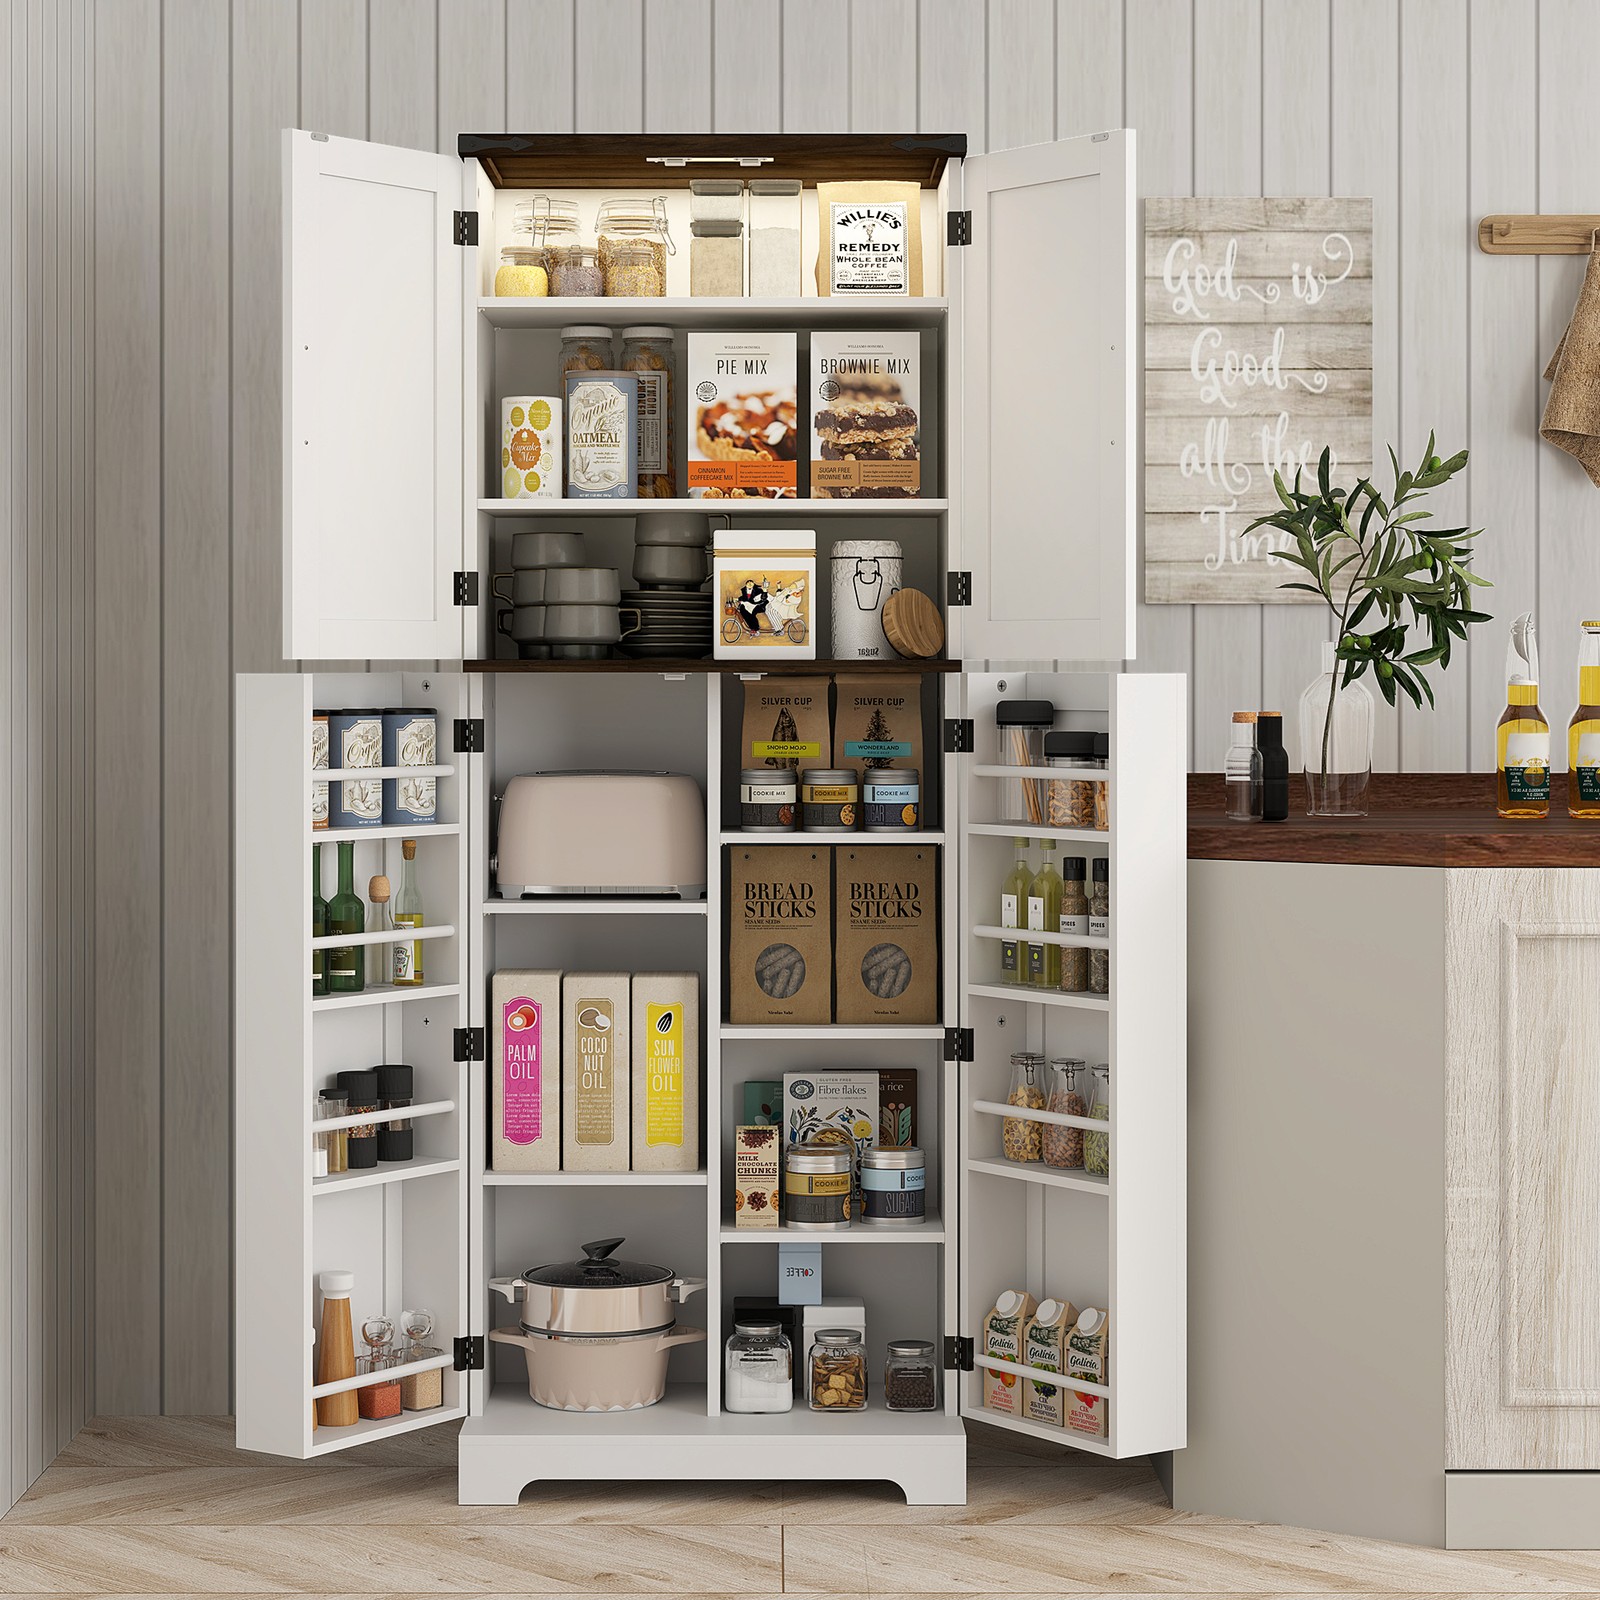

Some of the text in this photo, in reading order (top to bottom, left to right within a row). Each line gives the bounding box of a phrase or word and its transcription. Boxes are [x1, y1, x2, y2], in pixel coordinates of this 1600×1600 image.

[836, 209, 902, 230] WILLIE'S
[839, 243, 901, 252] REMEDY
[836, 255, 903, 263] WHOLE BEAN
[1163, 232, 1353, 319] God is
[717, 359, 768, 374] PIE MIX
[820, 358, 911, 374] BROWNIE MIX
[1190, 327, 1328, 408] Good
[571, 394, 620, 431] Organic
[572, 432, 621, 444] OATMEAL
[511, 441, 539, 454] Cupcake
[1180, 411, 1337, 495] all the
[518, 451, 536, 463] Mix
[818, 466, 852, 474] SUGAR FREE
[1200, 499, 1308, 571] Time
[761, 697, 812, 706] SILVER CUP
[854, 697, 905, 706] SILVER CUP
[743, 882, 814, 900] BREAD
[849, 882, 919, 900] BREAD
[743, 900, 817, 919] STICKS
[849, 900, 922, 919] STICKS
[507, 1044, 536, 1061] PALM
[580, 1036, 607, 1054] COCO
[653, 1039, 675, 1056] SUN
[509, 1062, 535, 1079] OIL
[583, 1054, 604, 1071] NUT
[648, 1057, 680, 1074] FLOWER
[582, 1072, 607, 1089] OIL
[652, 1074, 677, 1092] OIL
[887, 1082, 904, 1091] rice
[819, 1085, 867, 1095] Fibre flakes
[885, 1192, 916, 1214] SUGAR
[989, 1336, 1016, 1351] Galicia
[1029, 1346, 1058, 1362] Galicia
[1069, 1355, 1099, 1371] Galicia
